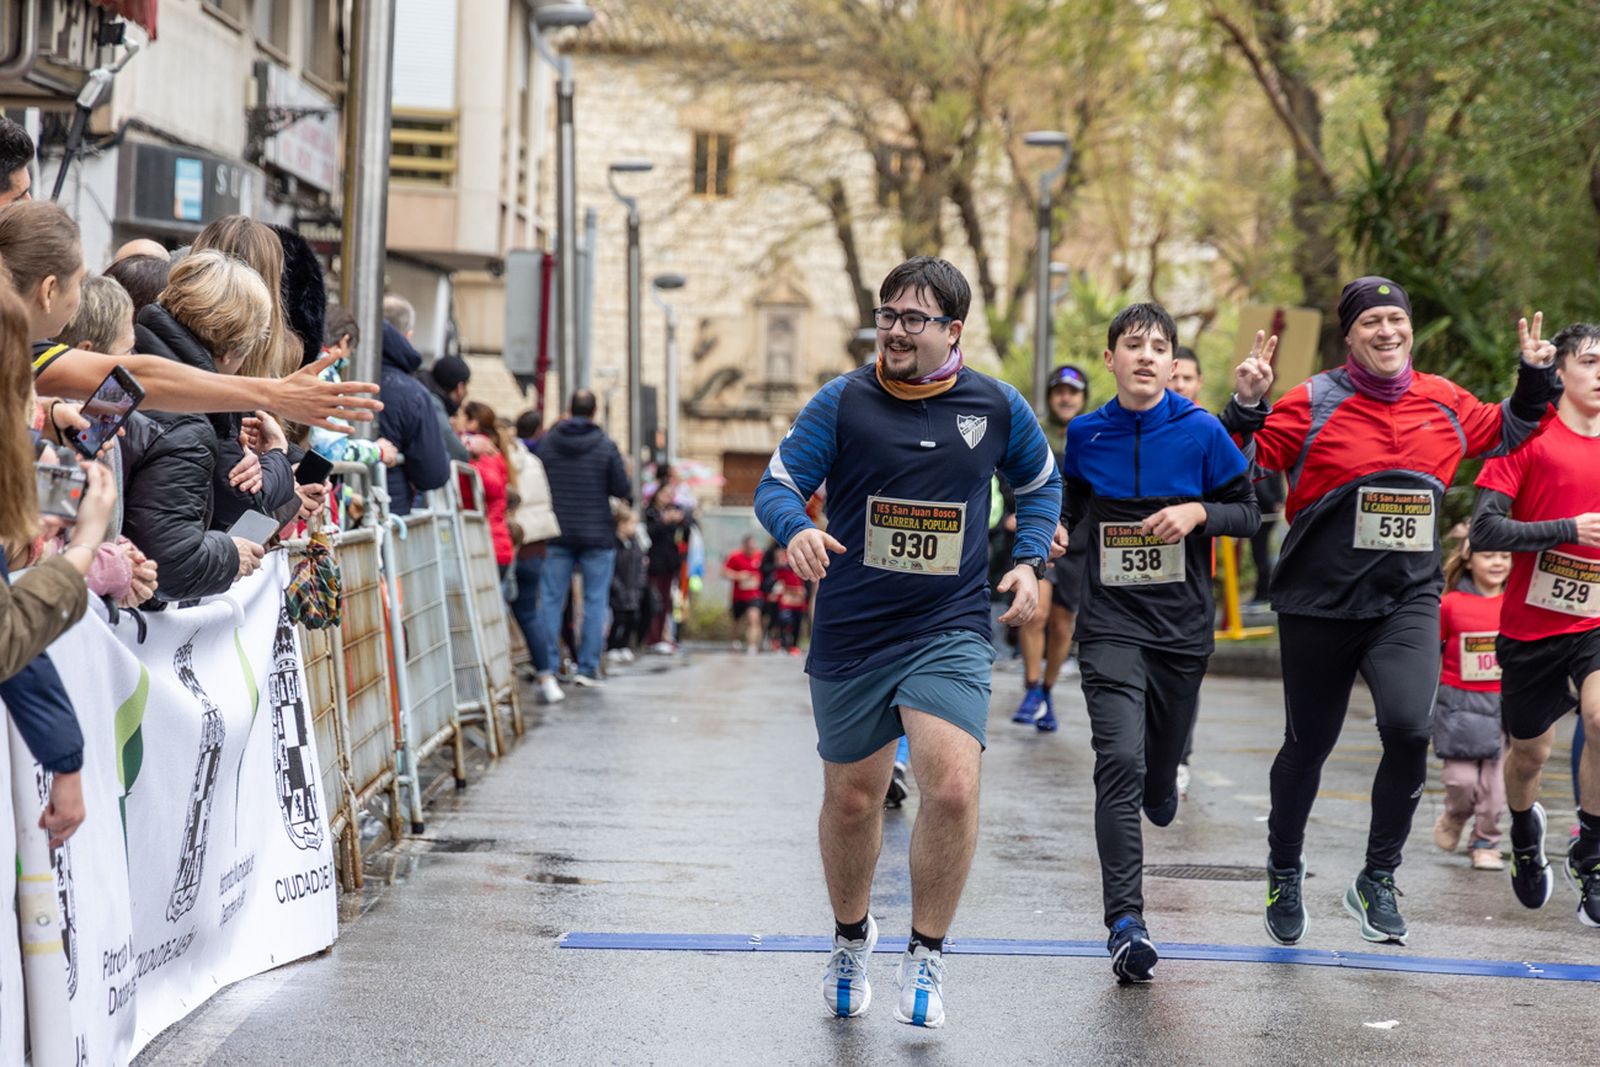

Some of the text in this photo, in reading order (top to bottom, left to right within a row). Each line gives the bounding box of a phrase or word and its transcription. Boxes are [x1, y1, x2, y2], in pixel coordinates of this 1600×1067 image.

[876, 503, 957, 518] IES San Juan Bosco
[1363, 502, 1431, 514] V CARRERA POPULAR
[874, 513, 959, 531] V CARRERA POPULAR
[1379, 516, 1417, 539] 536
[1106, 535, 1164, 546] V CARRERA POPU
[1119, 527, 1132, 536] San
[890, 531, 938, 560] 930
[1121, 548, 1161, 572] 538
[1547, 563, 1578, 578] CARRERA
[1551, 578, 1590, 604] 529
[275, 869, 320, 904] CIUDAD
